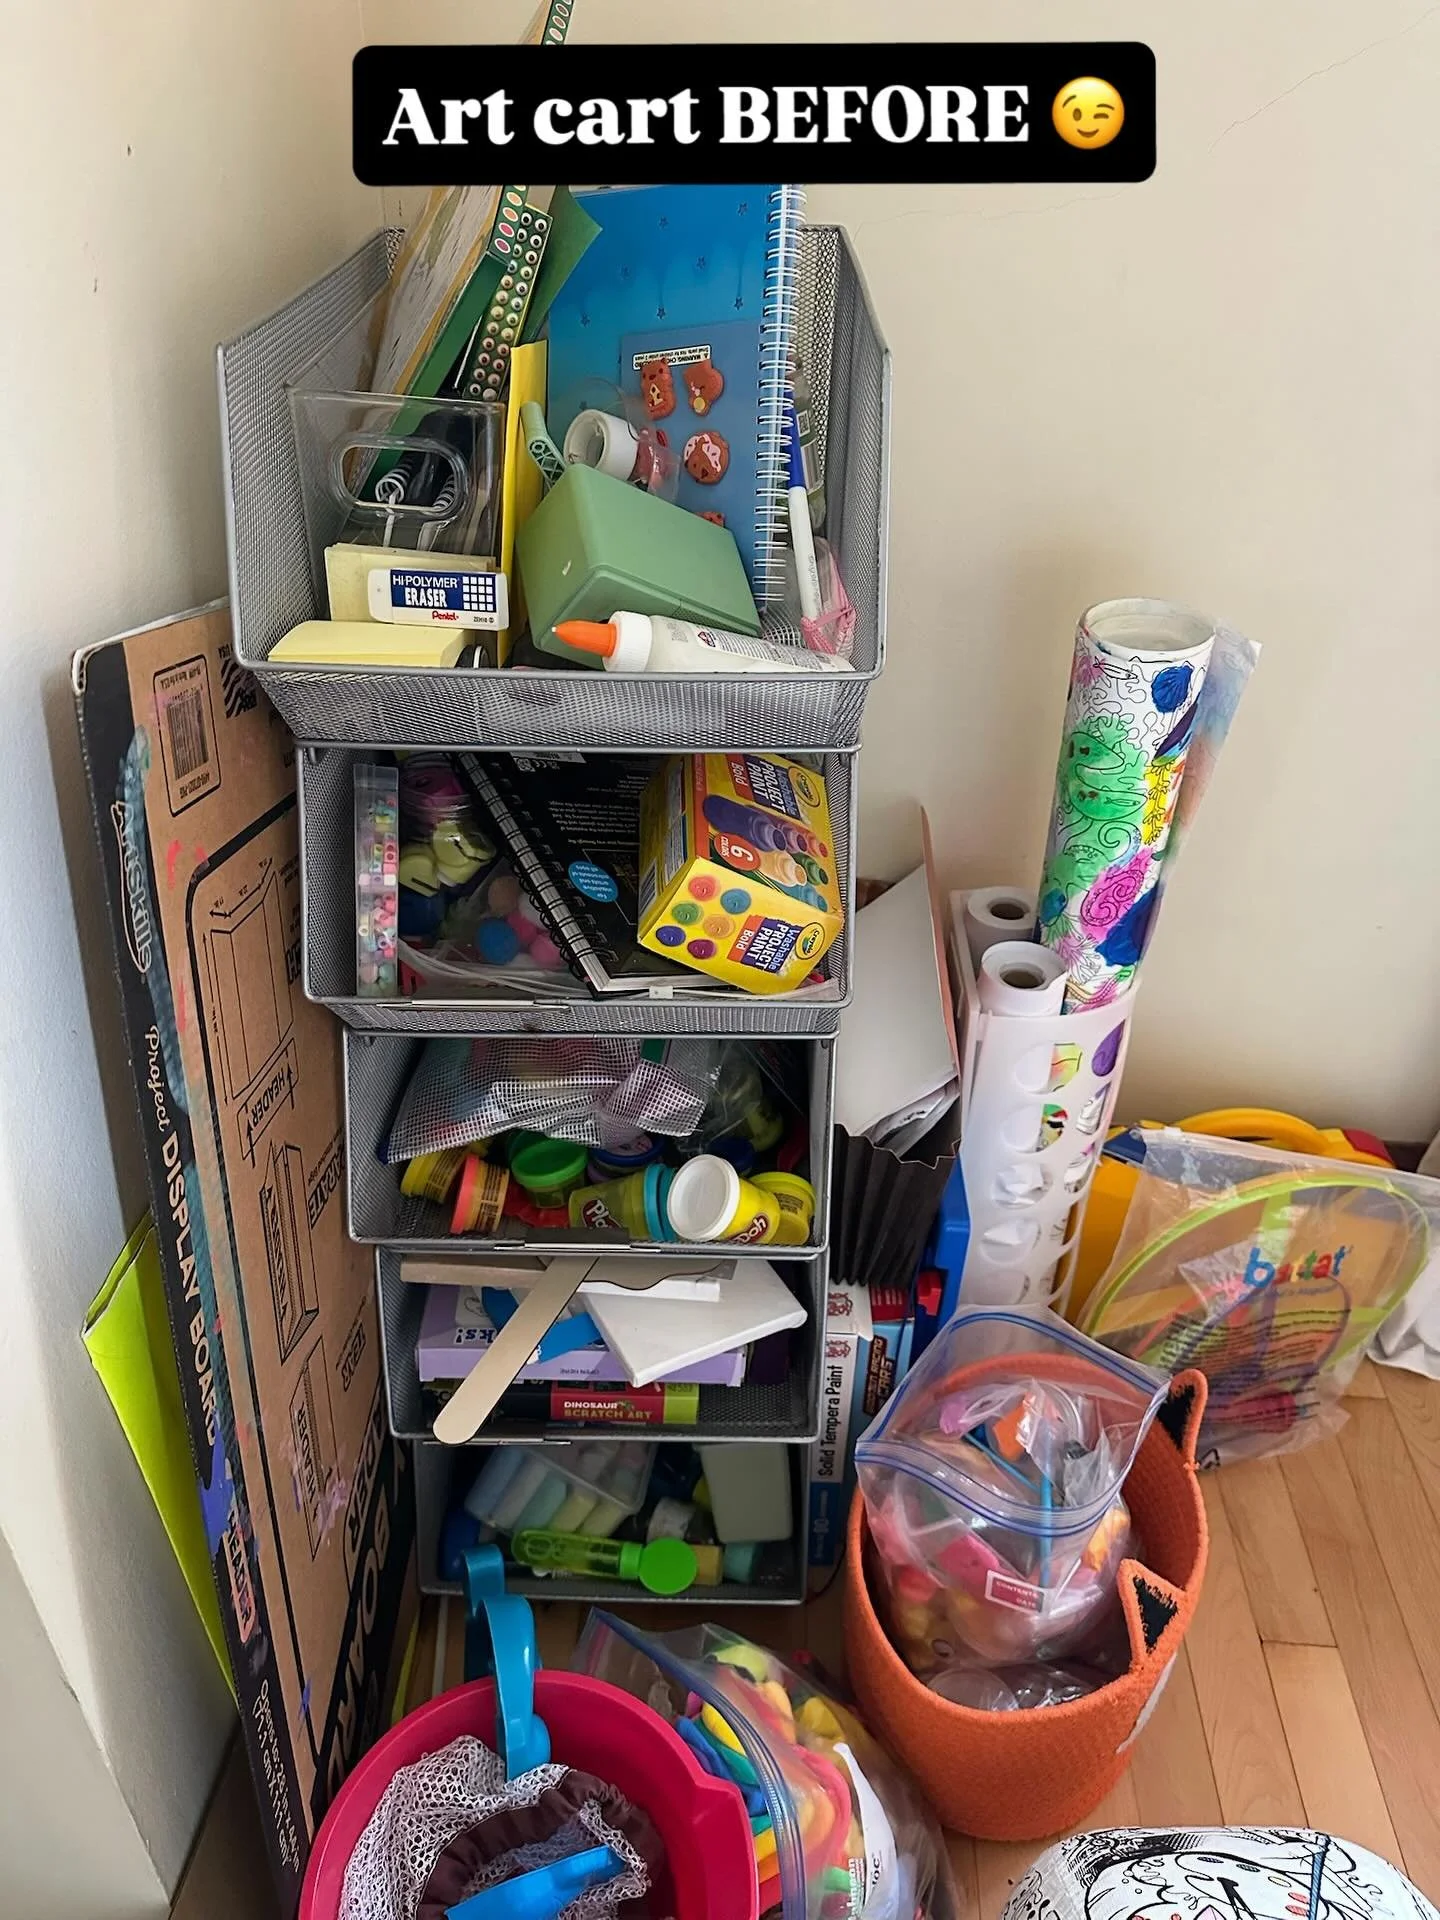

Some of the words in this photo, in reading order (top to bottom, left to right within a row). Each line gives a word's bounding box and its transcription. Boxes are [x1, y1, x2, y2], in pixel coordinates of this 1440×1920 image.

[404, 587, 447, 608] ERASER
[432, 610, 457, 621] Pentel
[731, 762, 747, 786] Bold
[748, 761, 769, 801] PAINT
[760, 761, 786, 813] PROJECT
[730, 844, 753, 862] 6
[113, 800, 152, 972] ArtSkills
[735, 930, 754, 951] Bold
[746, 926, 768, 961] PAINT
[757, 923, 789, 971] PROJECT
[768, 928, 800, 971] Washable
[805, 928, 820, 954] Crayola
[251, 1067, 286, 1131] HEADER
[145, 1024, 170, 1132] Project
[162, 1138, 200, 1303] DISPLAY
[307, 1148, 345, 1230] ARATE
[586, 1199, 609, 1228] Pla
[1243, 1247, 1345, 1289] battat
[825, 1364, 844, 1398] Paint
[564, 1401, 618, 1410] DINOSAUR
[564, 1409, 624, 1419] SCRATCH
[628, 1411, 653, 1420] ART
[821, 1398, 842, 1447] Tempera
[819, 1447, 833, 1477] Solid
[258, 1678, 276, 1743] Opens
